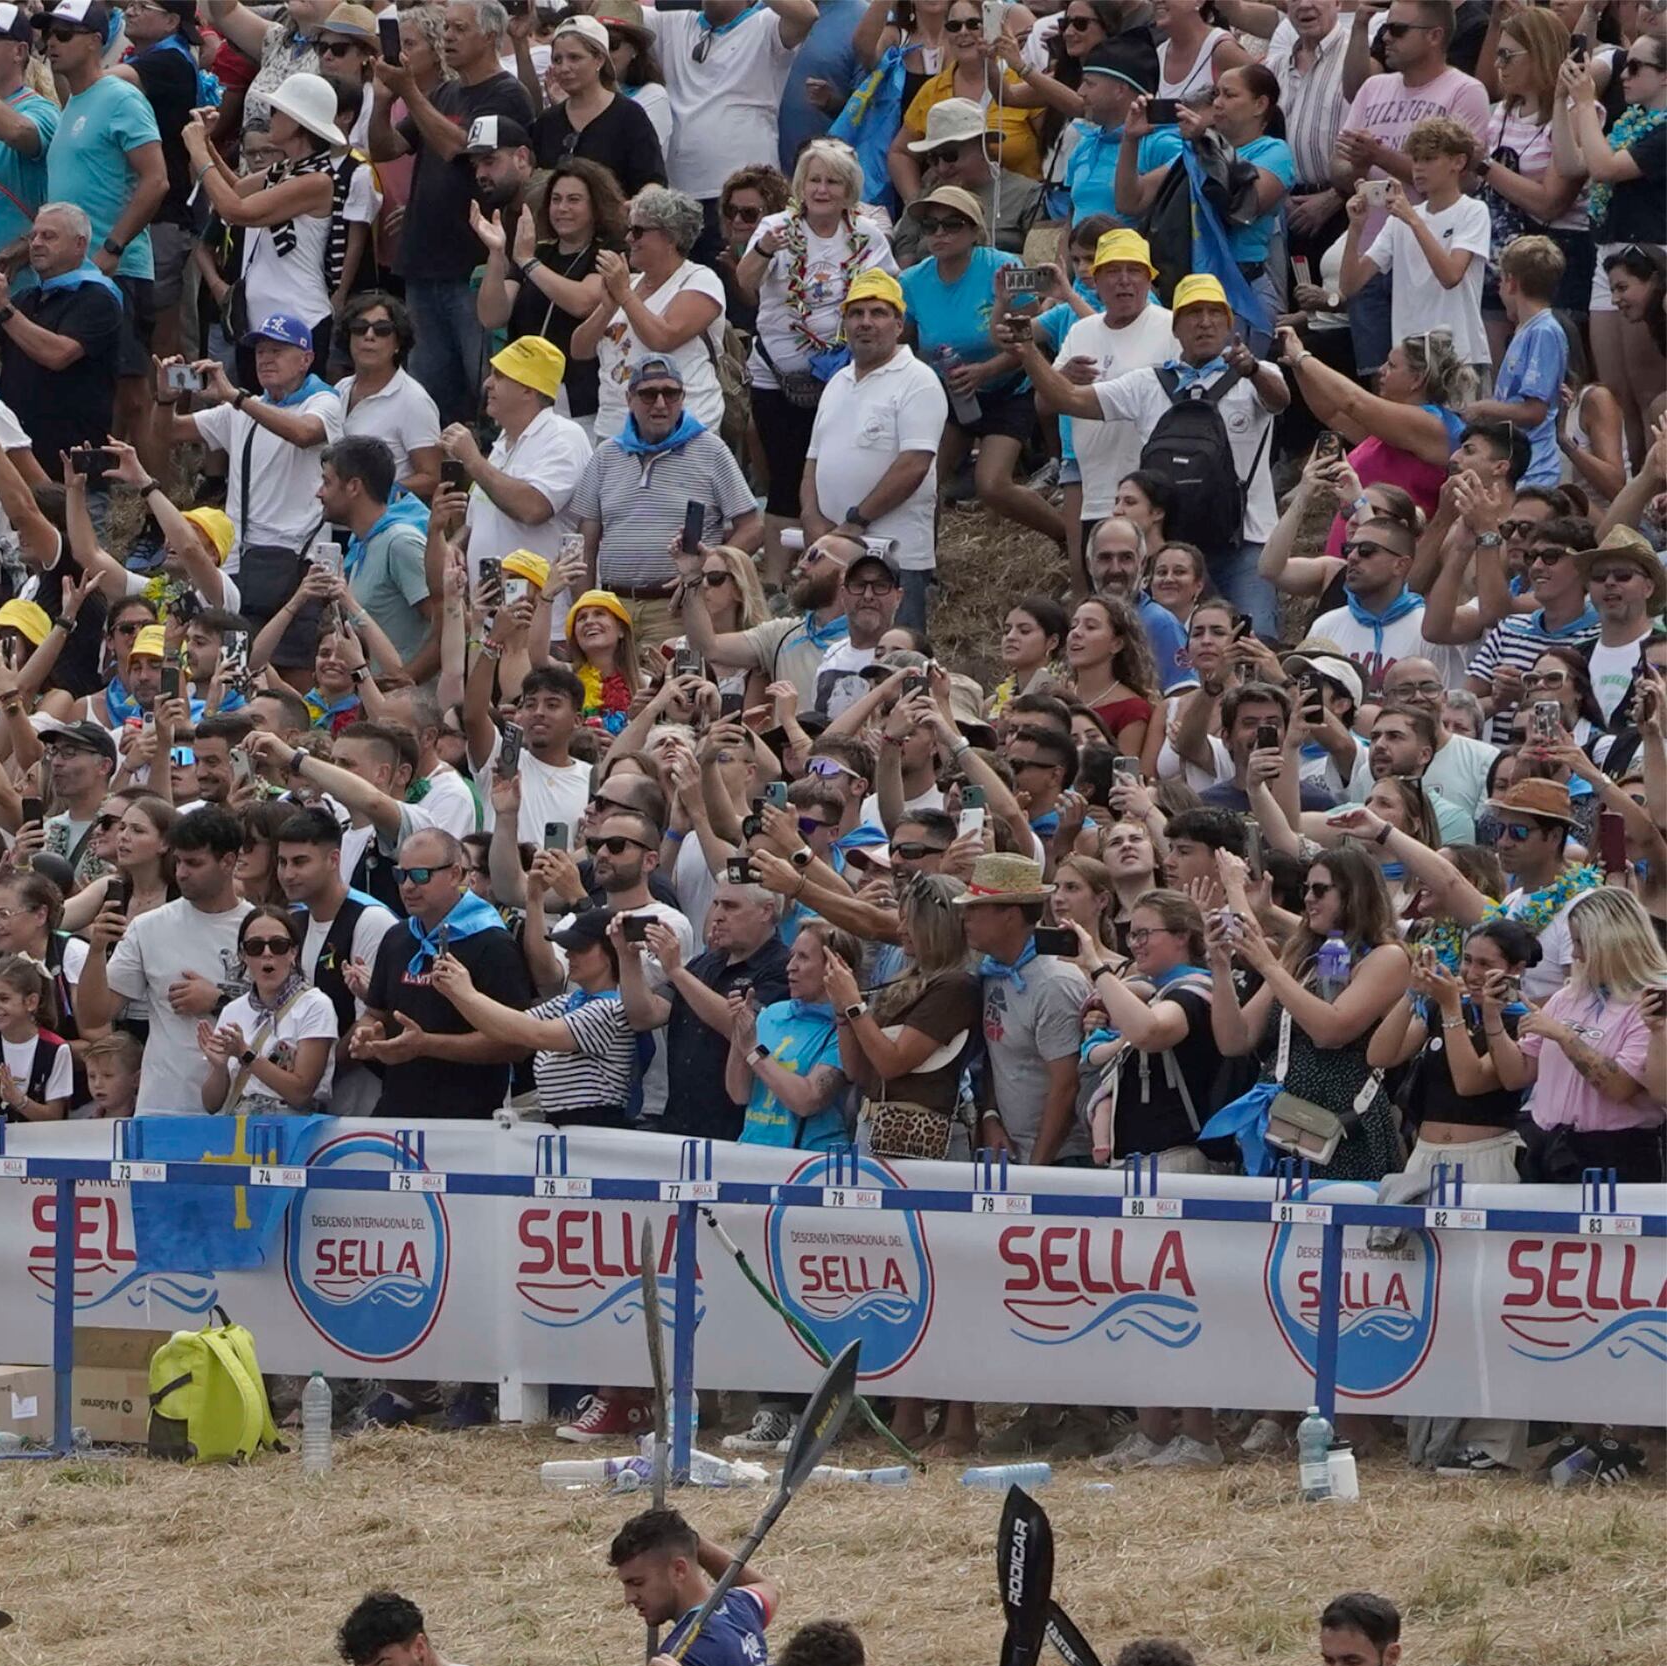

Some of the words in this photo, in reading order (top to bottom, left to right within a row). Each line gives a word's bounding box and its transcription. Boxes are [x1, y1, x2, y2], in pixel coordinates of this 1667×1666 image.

[119, 1166, 131, 1179] 73
[259, 1170, 271, 1183] 74
[399, 1175, 410, 1189] 75
[544, 1181, 556, 1194] 76
[669, 1186, 681, 1199] 77
[833, 1192, 845, 1206] 78
[982, 1198, 994, 1211] 79
[1131, 1201, 1144, 1215] 80
[1280, 1207, 1293, 1221] 81
[1435, 1213, 1447, 1226] 82
[312, 1214, 352, 1228] DESCENSO
[353, 1215, 409, 1230] INTERNACIONAL
[411, 1217, 426, 1230] DEL
[1589, 1219, 1602, 1232] 83
[790, 1230, 830, 1245] DESCENSO
[830, 1232, 886, 1247] INTERNACIONAL
[888, 1235, 903, 1247] DEL
[315, 1238, 422, 1278] SELLA
[999, 1225, 1196, 1297] SELLA
[799, 1254, 909, 1295] SELLA
[1007, 1517, 1030, 1607] RODICAR
